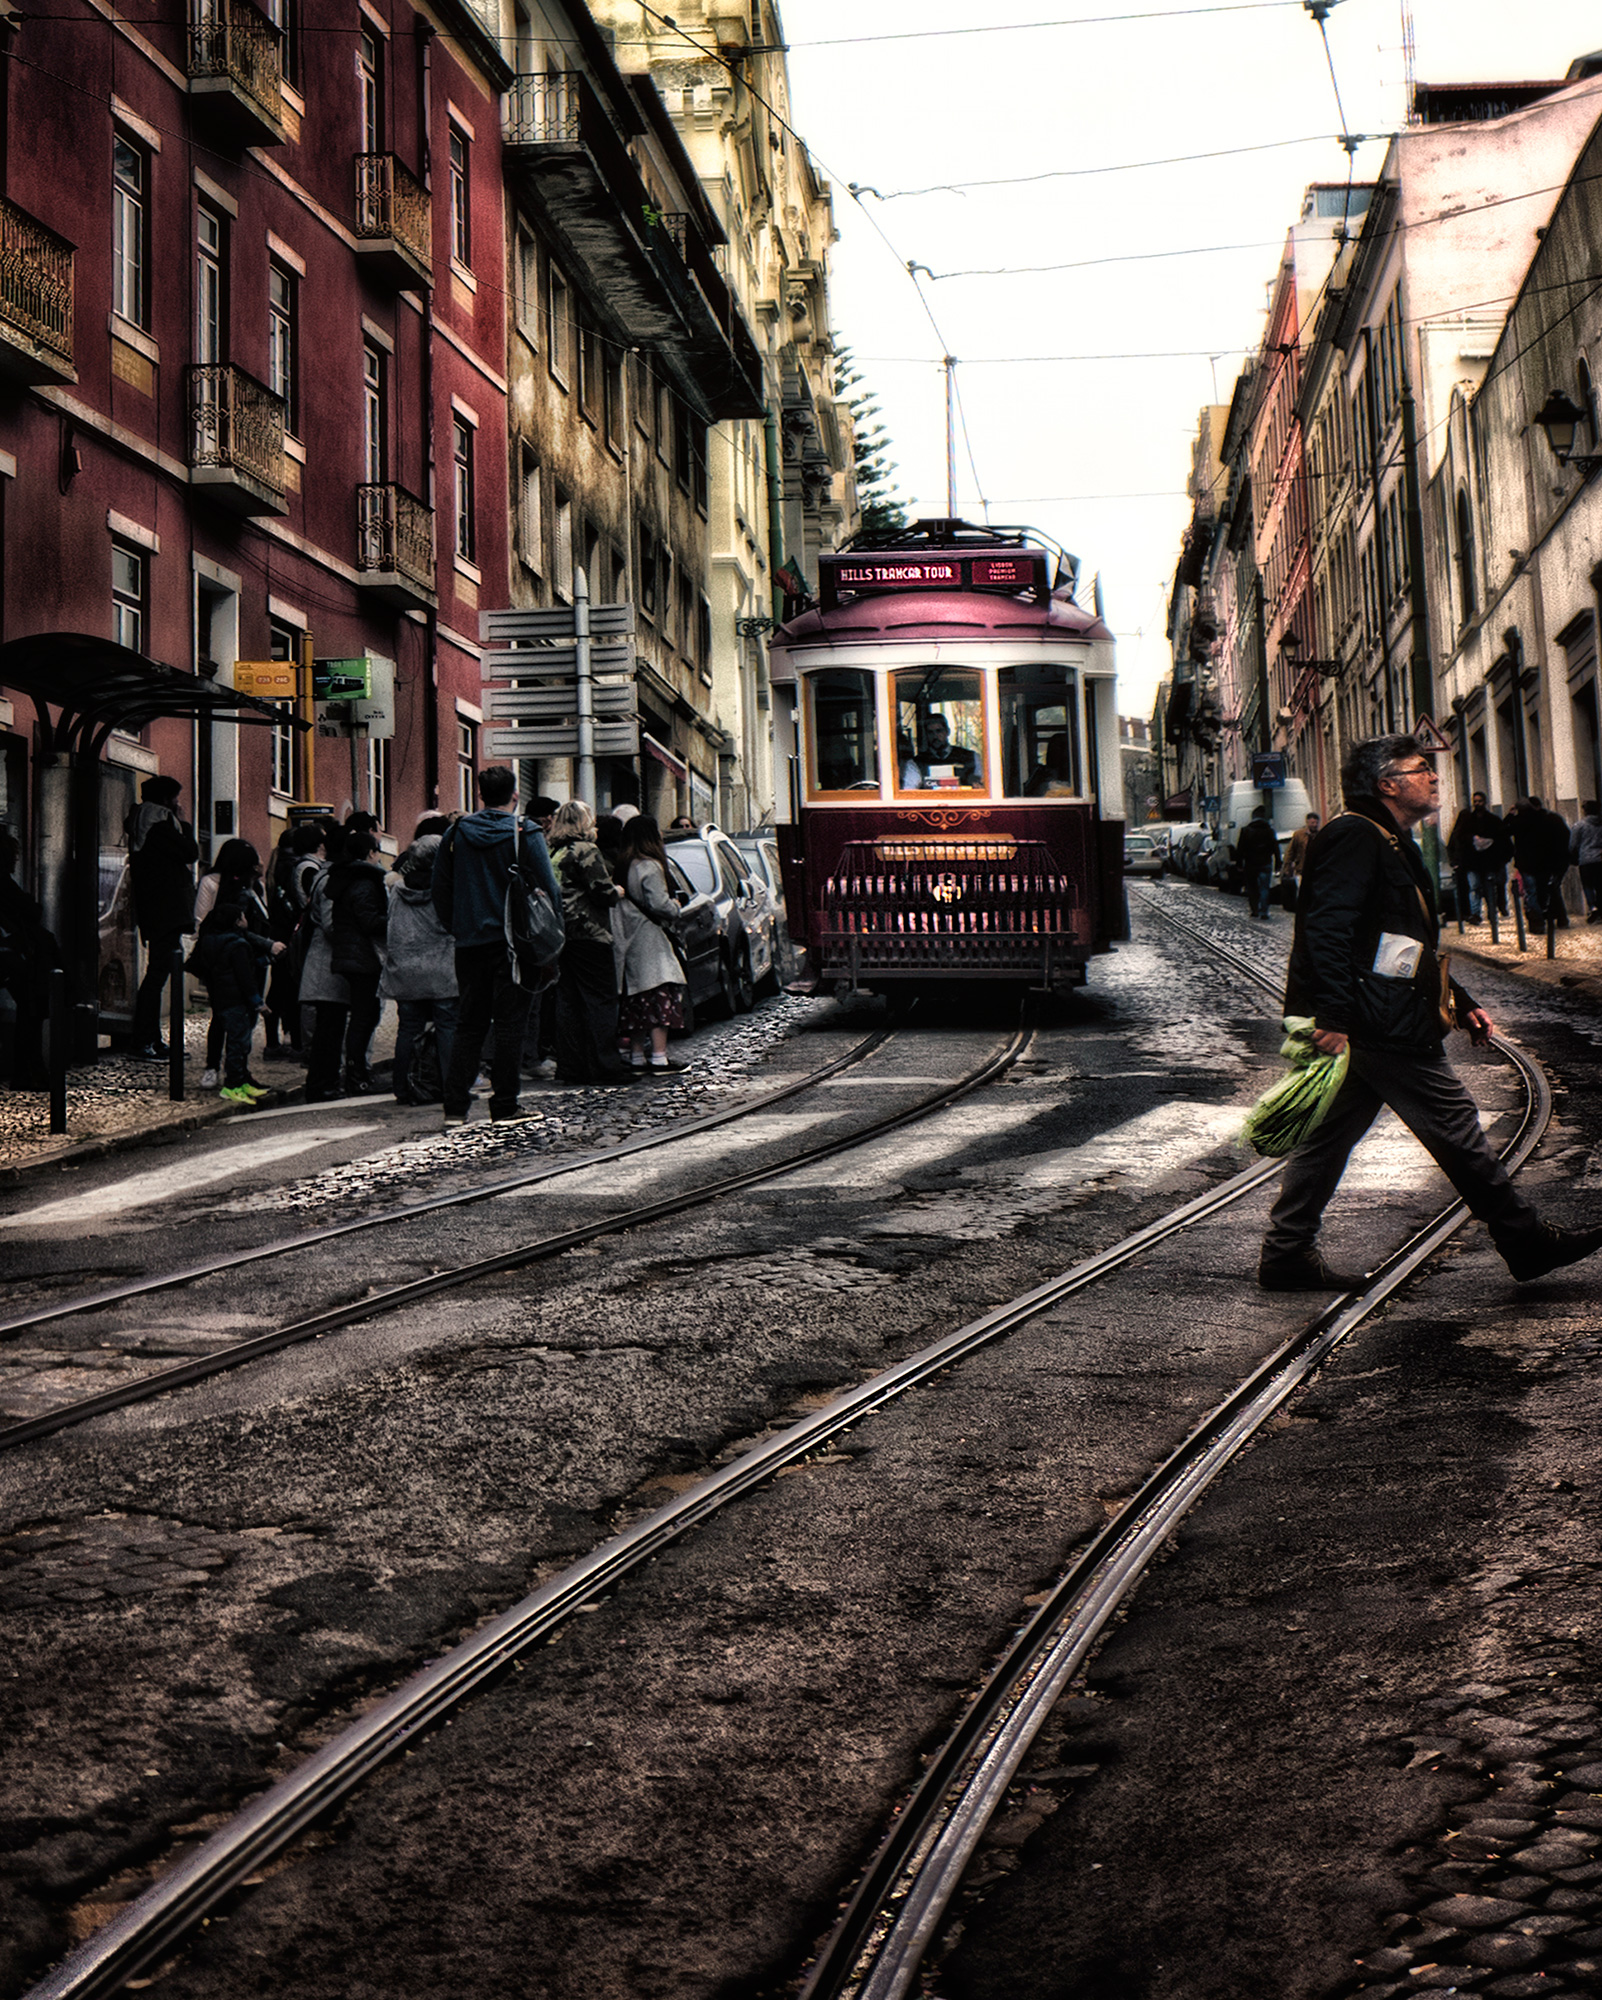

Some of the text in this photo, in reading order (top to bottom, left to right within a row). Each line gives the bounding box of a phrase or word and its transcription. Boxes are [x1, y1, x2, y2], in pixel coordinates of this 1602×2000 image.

[841, 566, 953, 581] HILLS TRAMCAR TOUR
[933, 646, 941, 660] 7
